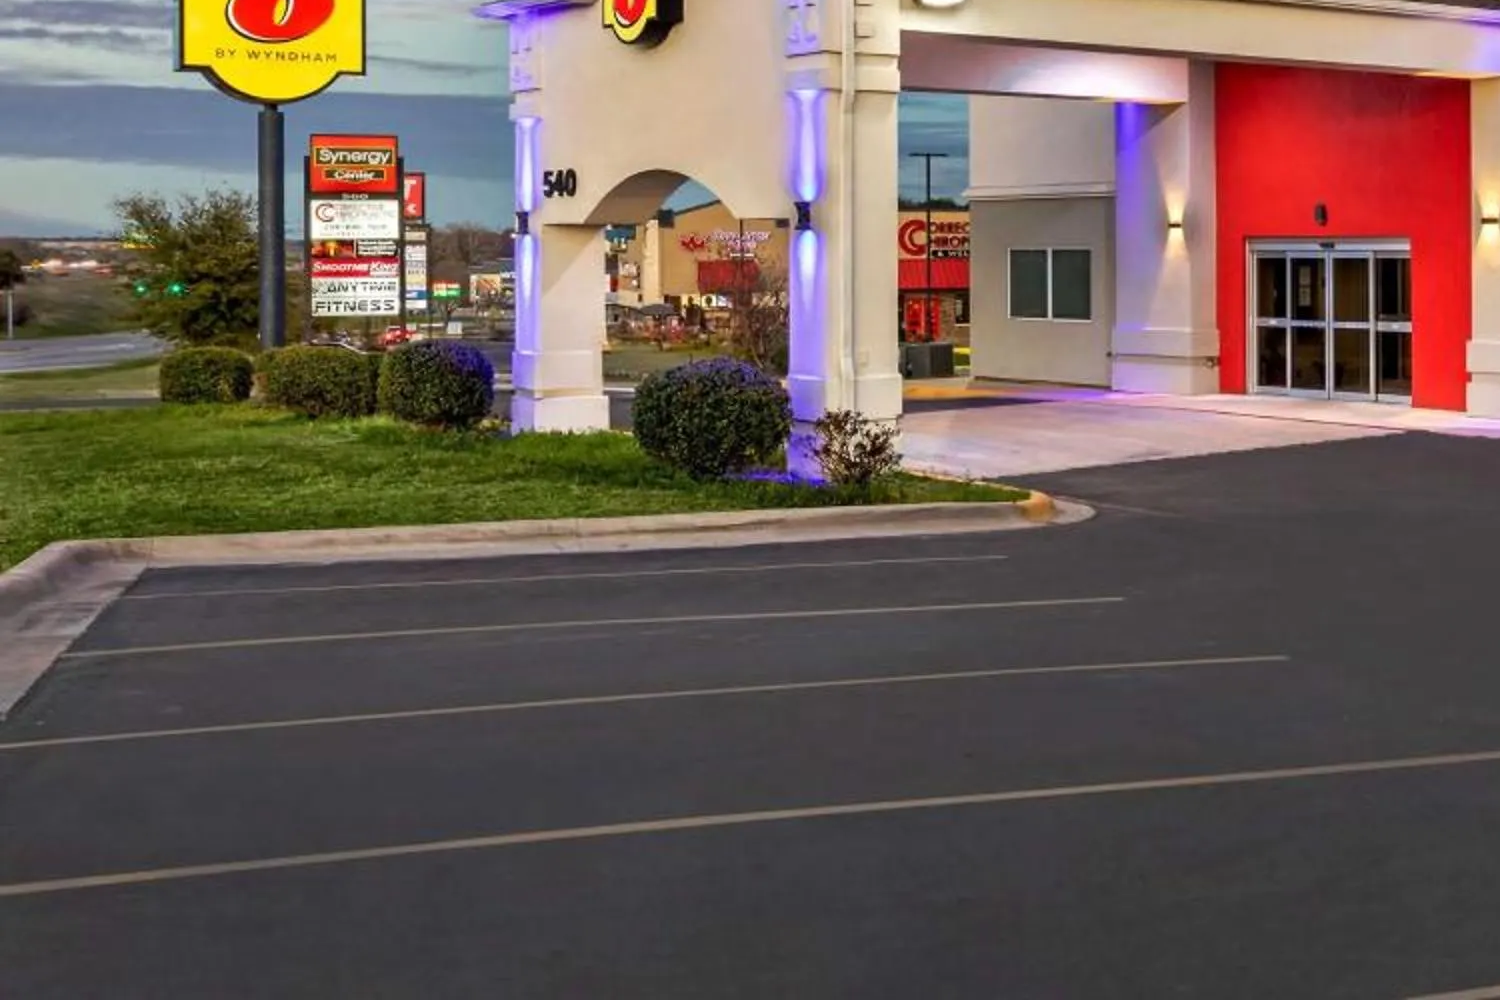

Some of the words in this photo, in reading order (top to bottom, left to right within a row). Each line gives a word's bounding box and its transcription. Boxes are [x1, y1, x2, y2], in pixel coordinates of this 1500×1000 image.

[214, 47, 237, 60] BY
[246, 49, 338, 64] WYNDHAM
[319, 149, 391, 165] Synergy
[333, 168, 376, 181] Center
[543, 168, 577, 198] 540
[326, 281, 396, 293] ANYTIME
[315, 299, 395, 313] FITNESS
